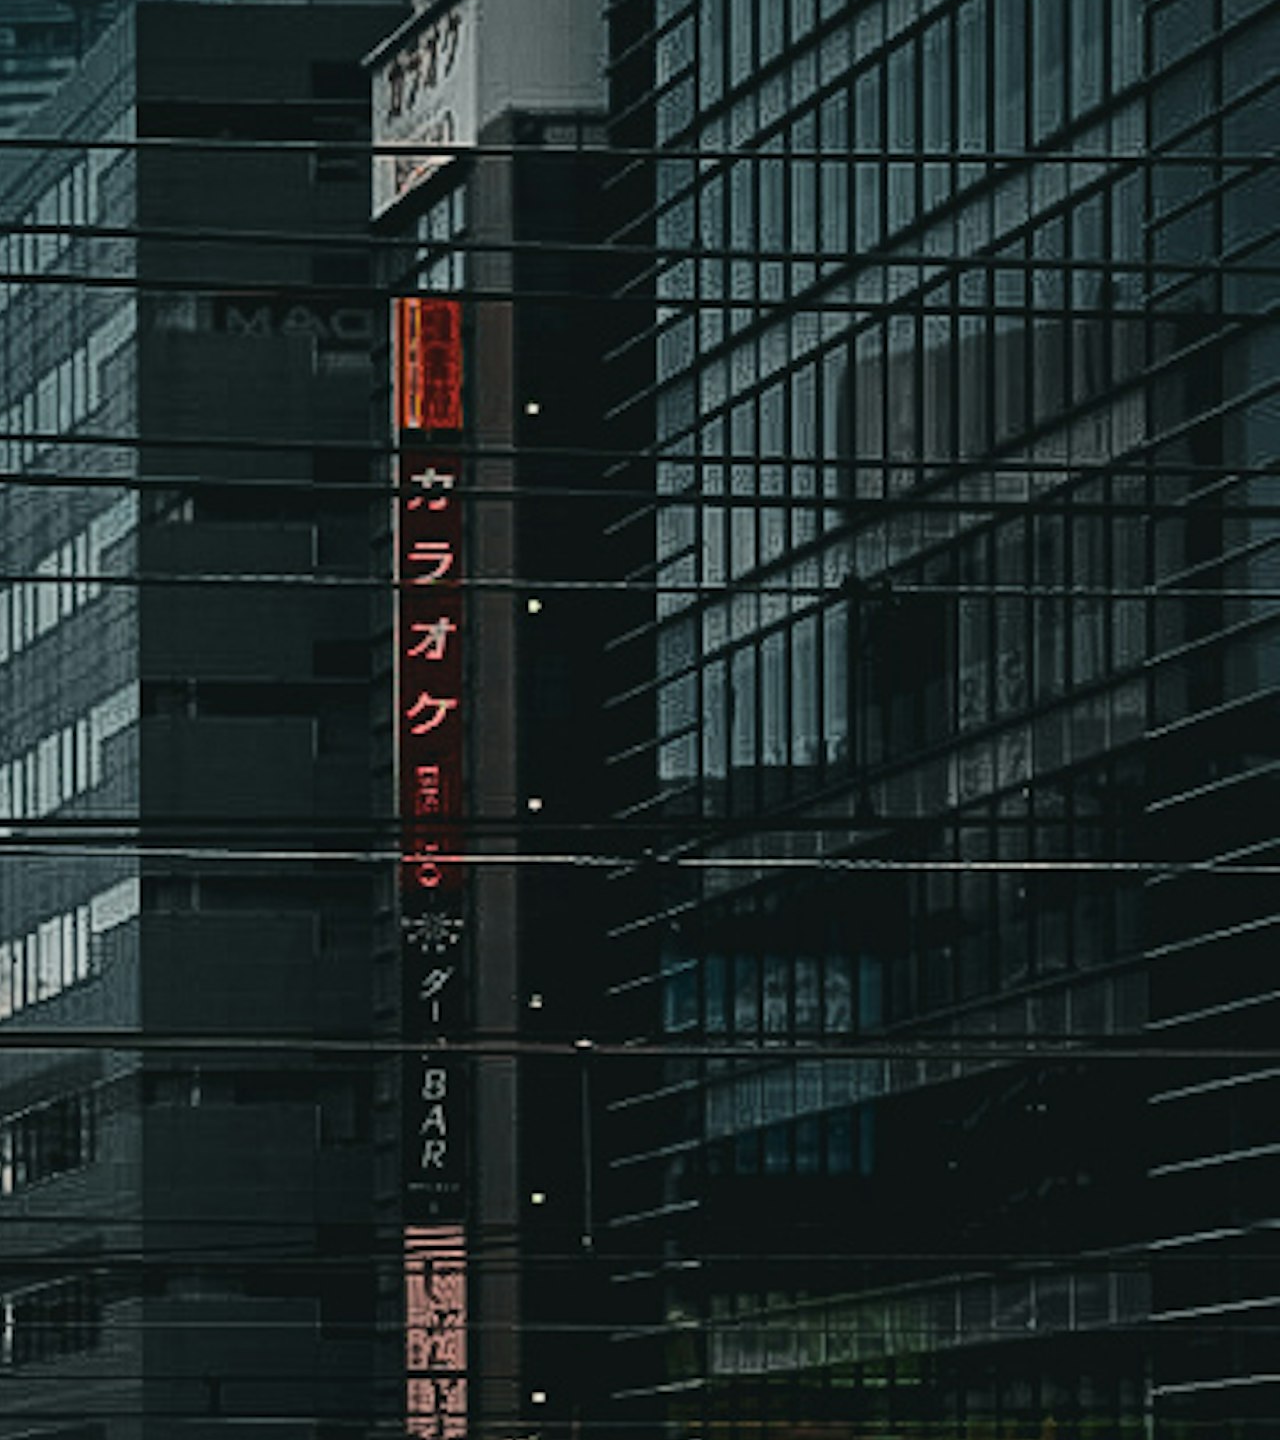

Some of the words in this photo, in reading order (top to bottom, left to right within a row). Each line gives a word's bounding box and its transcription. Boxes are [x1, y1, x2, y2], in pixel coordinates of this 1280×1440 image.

[406, 467, 458, 736] カラオケ
[419, 1068, 448, 1170] BAR
